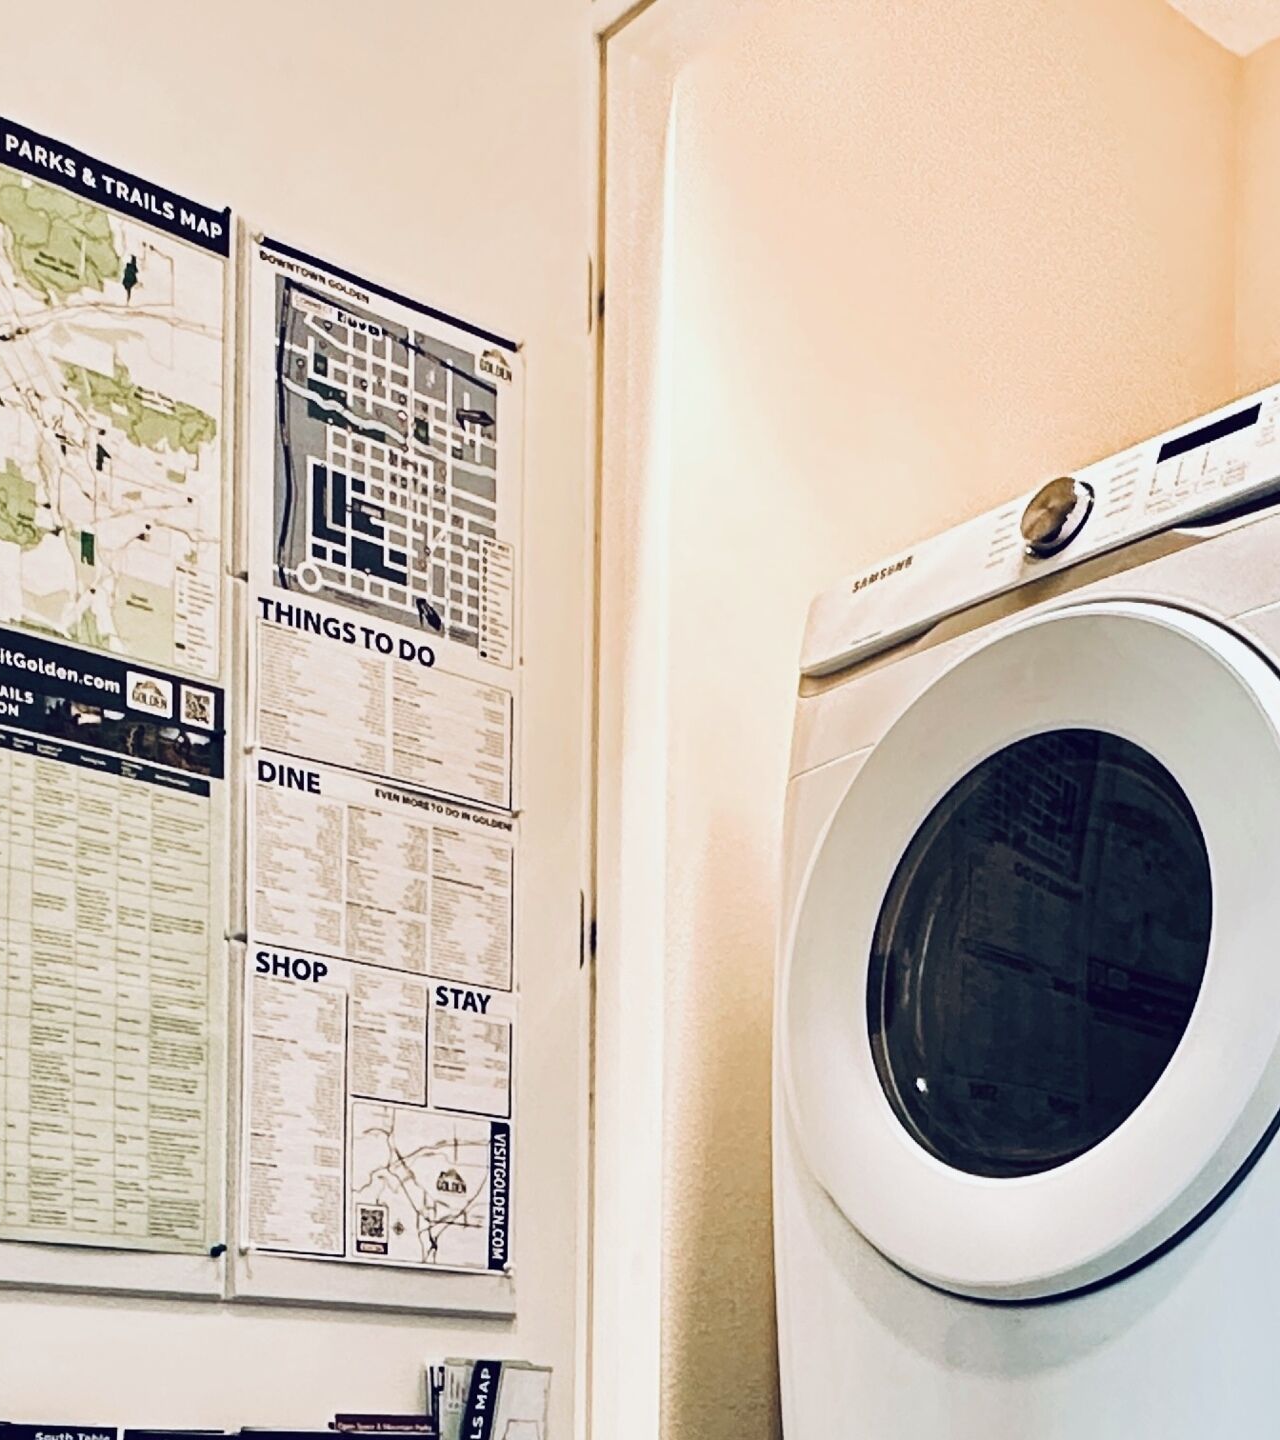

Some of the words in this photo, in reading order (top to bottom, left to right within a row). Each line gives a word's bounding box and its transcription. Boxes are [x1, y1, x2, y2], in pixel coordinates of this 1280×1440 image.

[5, 133, 77, 178] PARKS
[82, 167, 97, 188] &
[102, 174, 175, 220] TRAILS
[180, 215, 223, 241] MAP
[259, 250, 326, 285] DOWNTOWN
[328, 279, 370, 304] GOLDEN
[258, 596, 357, 645] THINGS
[361, 627, 393, 655] TO
[399, 638, 436, 668] DO
[257, 759, 321, 795] DINE
[255, 951, 328, 983] SHOP
[435, 986, 491, 1014] STAY
[491, 1133, 507, 1260] VISITGOLDEN.COM
[475, 1367, 492, 1410] MAP
